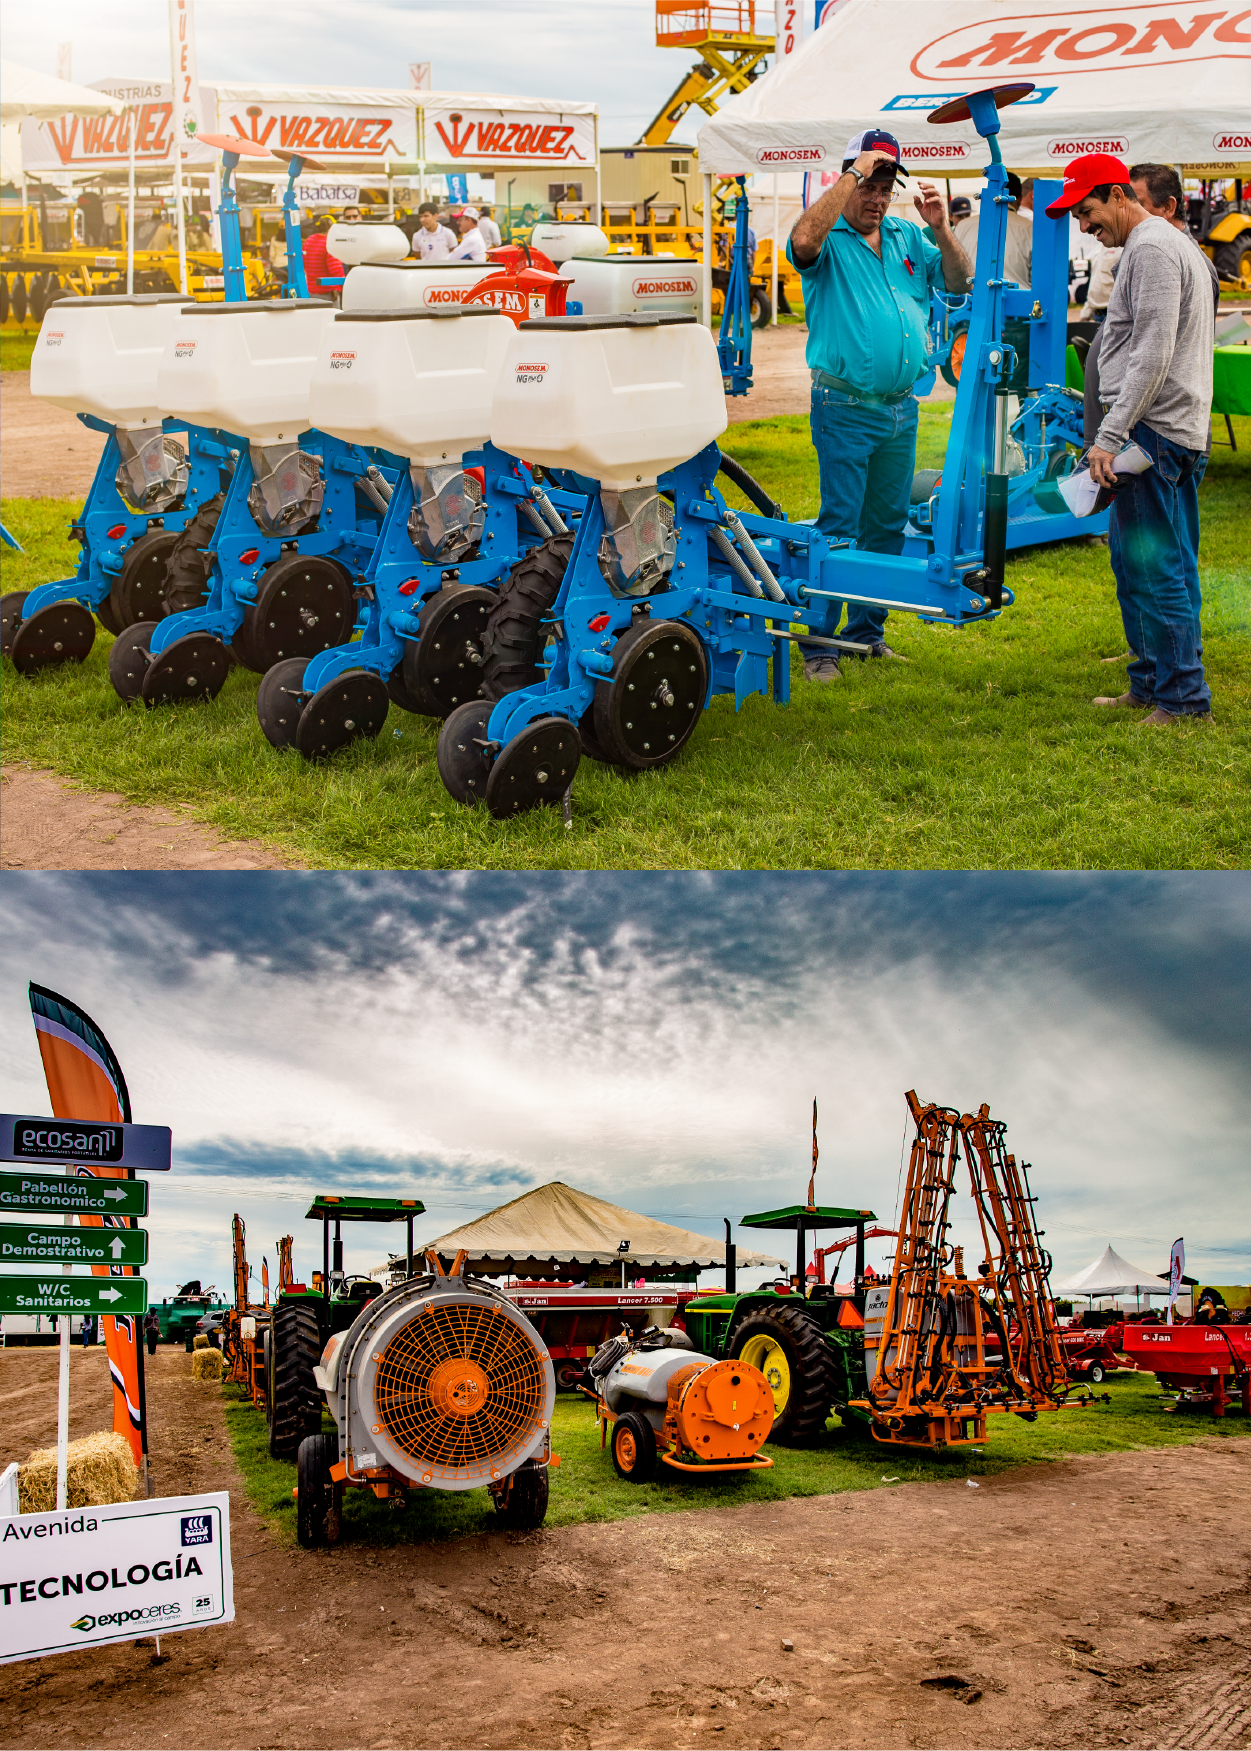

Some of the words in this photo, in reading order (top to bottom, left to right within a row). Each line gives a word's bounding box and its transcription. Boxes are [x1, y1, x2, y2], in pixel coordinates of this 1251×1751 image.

[280, 116, 392, 149] VAZQUEZ
[477, 122, 574, 154] VAZQUEZ
[900, 145, 965, 158] MONOSEM
[1052, 141, 1124, 154] MONOSEM
[760, 149, 822, 162] MONOSEM
[300, 185, 357, 201] Babatsa
[636, 280, 693, 294] MONOSEM
[22, 1129, 115, 1156] ecosan
[21, 1180, 87, 1195] Pabellón
[0, 1191, 106, 1207] Gastronomico
[27, 1233, 81, 1247] Campo
[2, 1243, 105, 1257] Demostrativo
[38, 1283, 70, 1296] W/C
[16, 1295, 91, 1307] Sanitarios
[1152, 1333, 1171, 1342] Jan
[3, 1516, 98, 1542] Avenida
[184, 1535, 209, 1544] YARA
[195, 1598, 211, 1607] 25
[98, 1602, 181, 1627] expoceres
